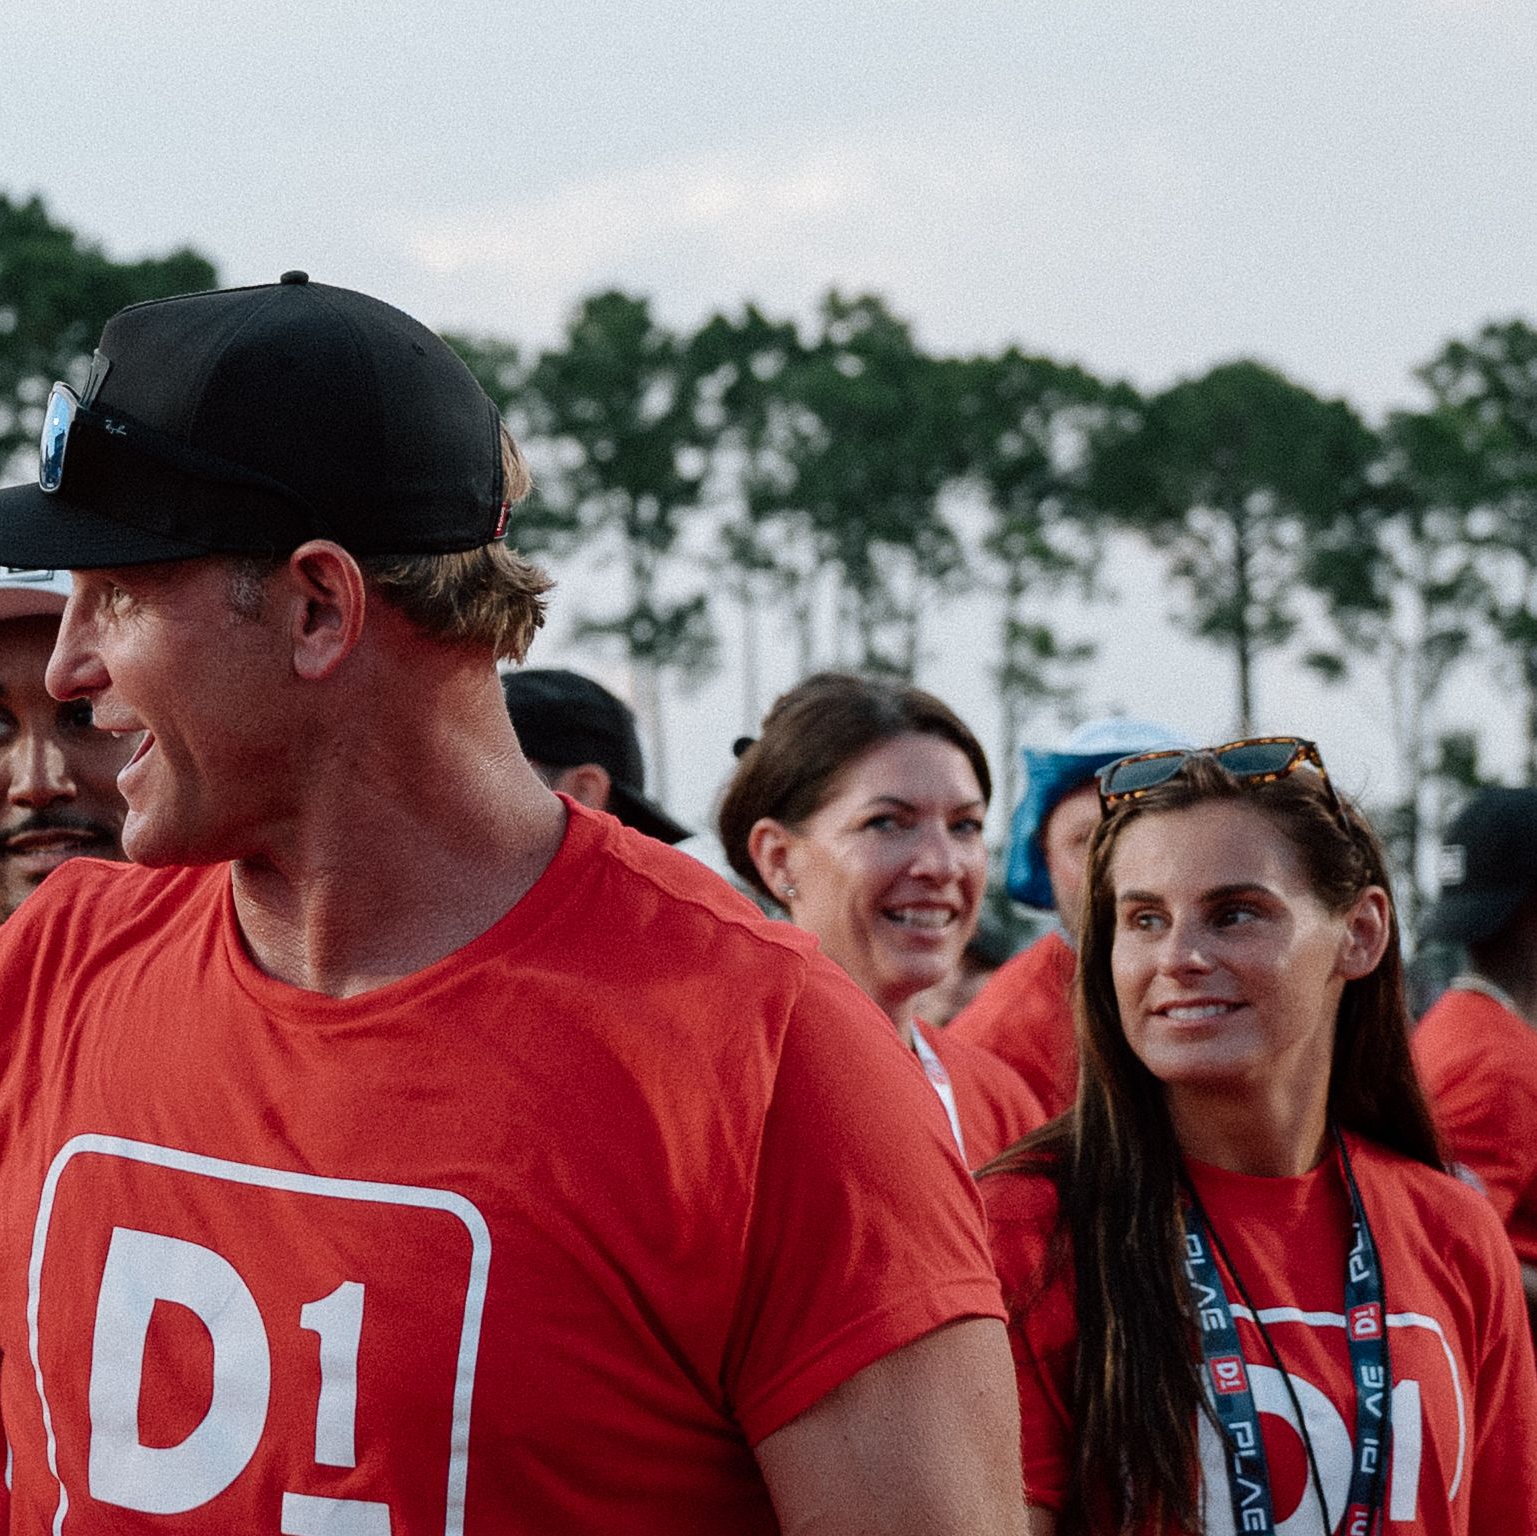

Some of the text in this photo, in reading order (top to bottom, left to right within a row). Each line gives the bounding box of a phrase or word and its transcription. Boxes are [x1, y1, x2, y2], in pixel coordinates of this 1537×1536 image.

[1185, 1233, 1227, 1331] PLAE
[1354, 1306, 1378, 1335] D1
[1216, 1361, 1241, 1390] D1
[1228, 1421, 1267, 1531] PLAE
